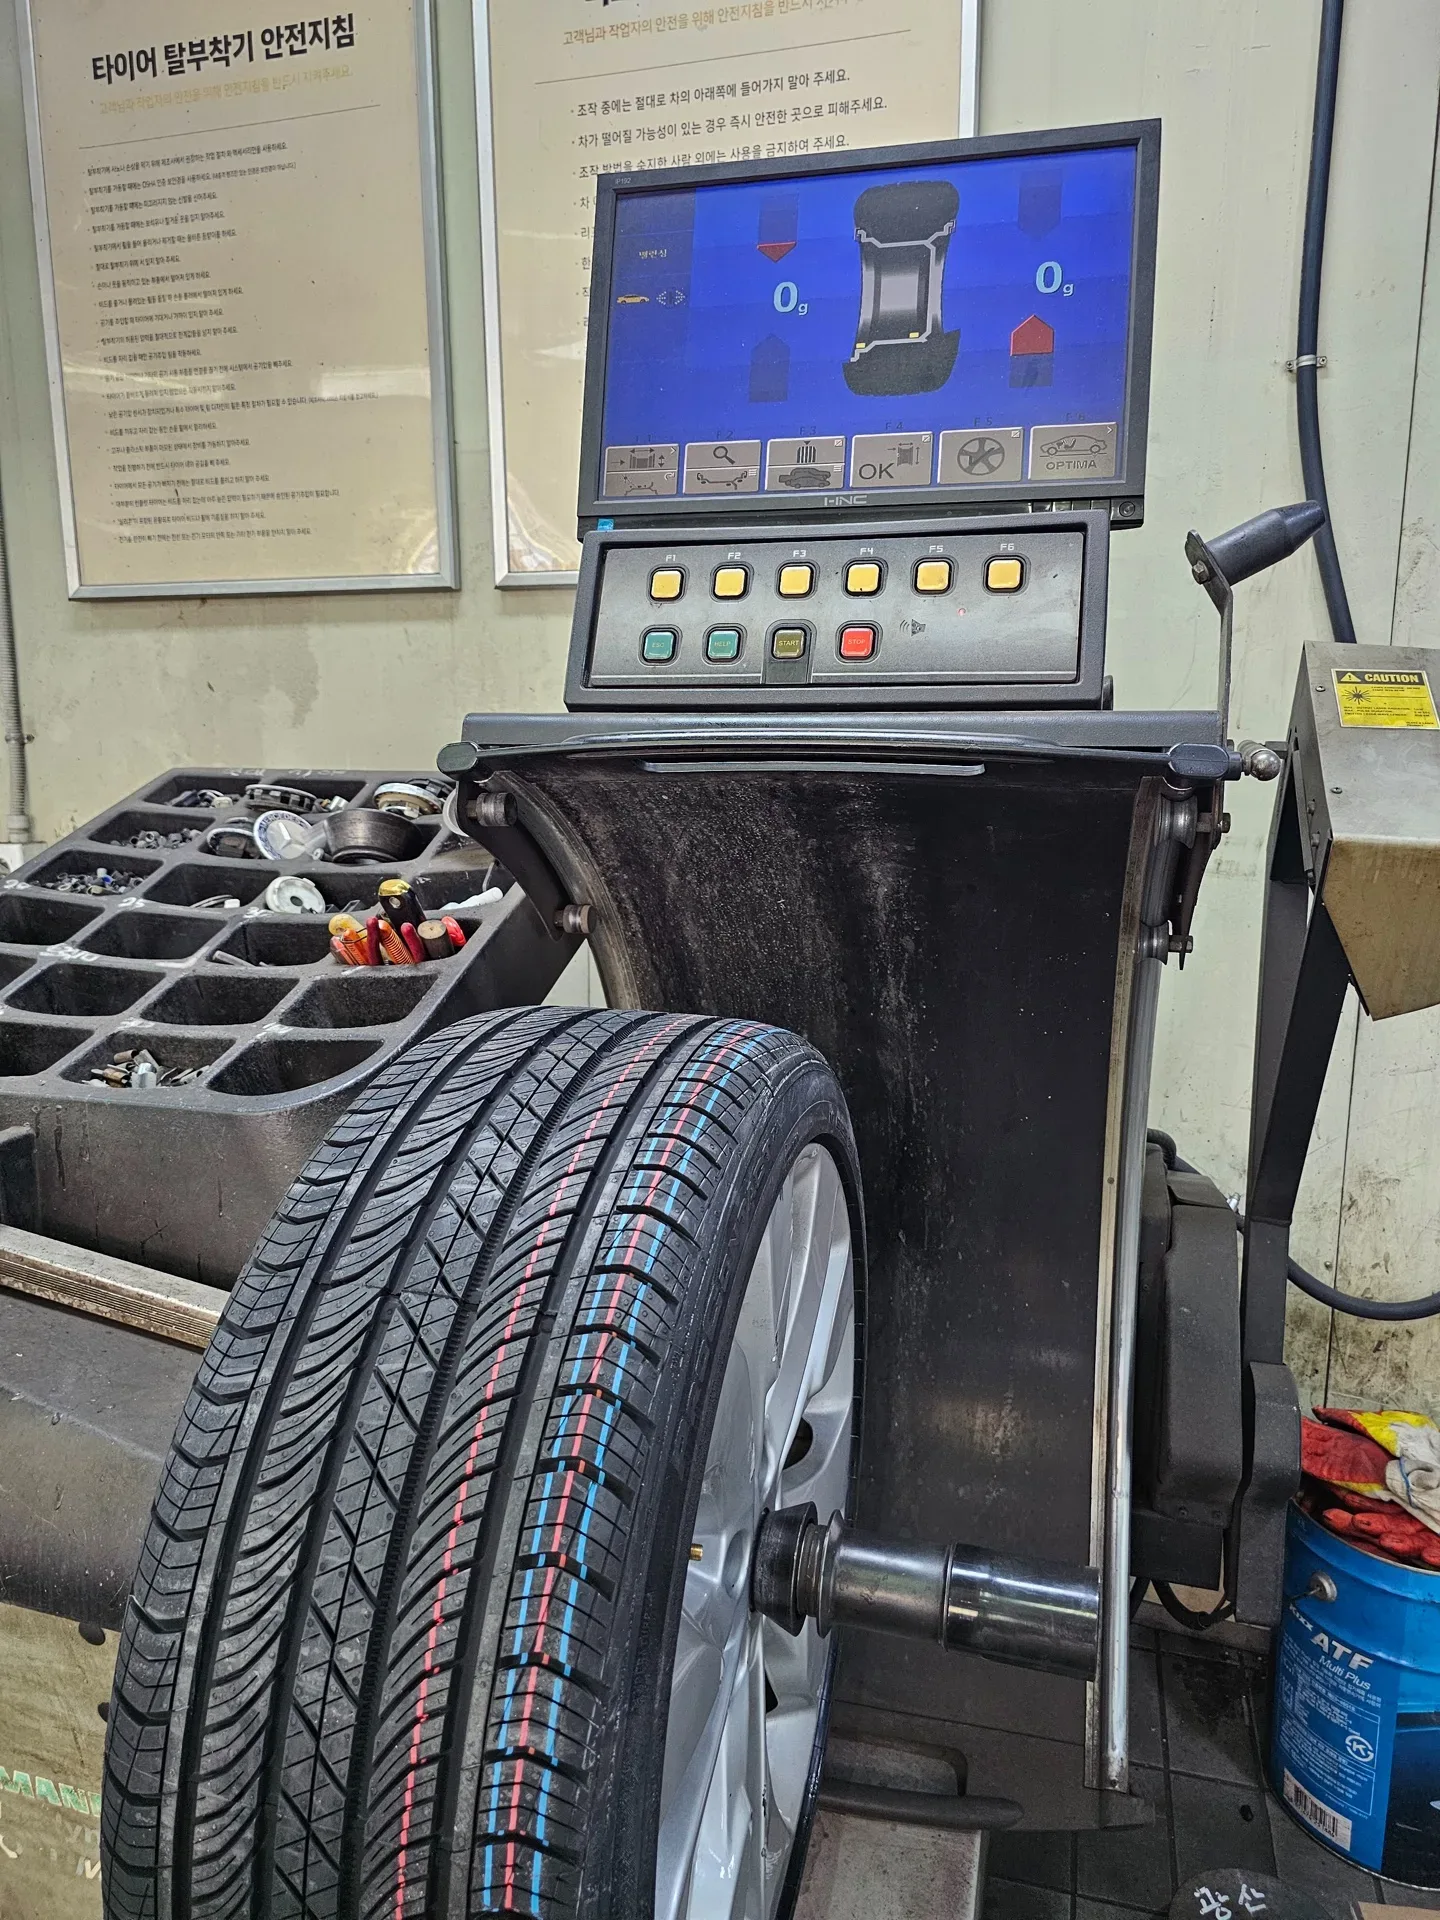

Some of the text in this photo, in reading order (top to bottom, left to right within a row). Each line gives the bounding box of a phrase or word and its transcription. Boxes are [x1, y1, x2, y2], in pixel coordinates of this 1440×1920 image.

[563, 27, 606, 45] 고객님과
[609, 19, 652, 39] 작업자의
[656, 14, 688, 32] 안전을
[692, 10, 715, 27] 위해
[717, 1, 775, 23] 안전지침을
[92, 13, 356, 85] 타이어 탈부착기 안전지침
[578, 69, 849, 116] 조작 중에는 절대로 차의 아래쪽에 들어가지 말아 주세요.
[578, 97, 887, 148] 차가 떨어질 가능성이 있는 경우 즉시 안전한 곳으로 피해주세요.
[579, 165, 599, 179] 조작
[730, 145, 762, 160] 사용을
[766, 138, 809, 157] 금지하여
[812, 134, 850, 151] 주세요.
[580, 196, 590, 209] 차
[858, 463, 894, 480] OK
[1045, 460, 1097, 471] OPTIMA
[792, 550, 807, 558] F3
[859, 547, 874, 555] F4
[929, 545, 944, 553] F5
[1000, 543, 1015, 551] F6
[727, 552, 741, 560] F2
[1364, 673, 1420, 683] CAUTION
[1310, 1632, 1375, 1671] ATF
[1319, 1655, 1371, 1690] Multi Plus
